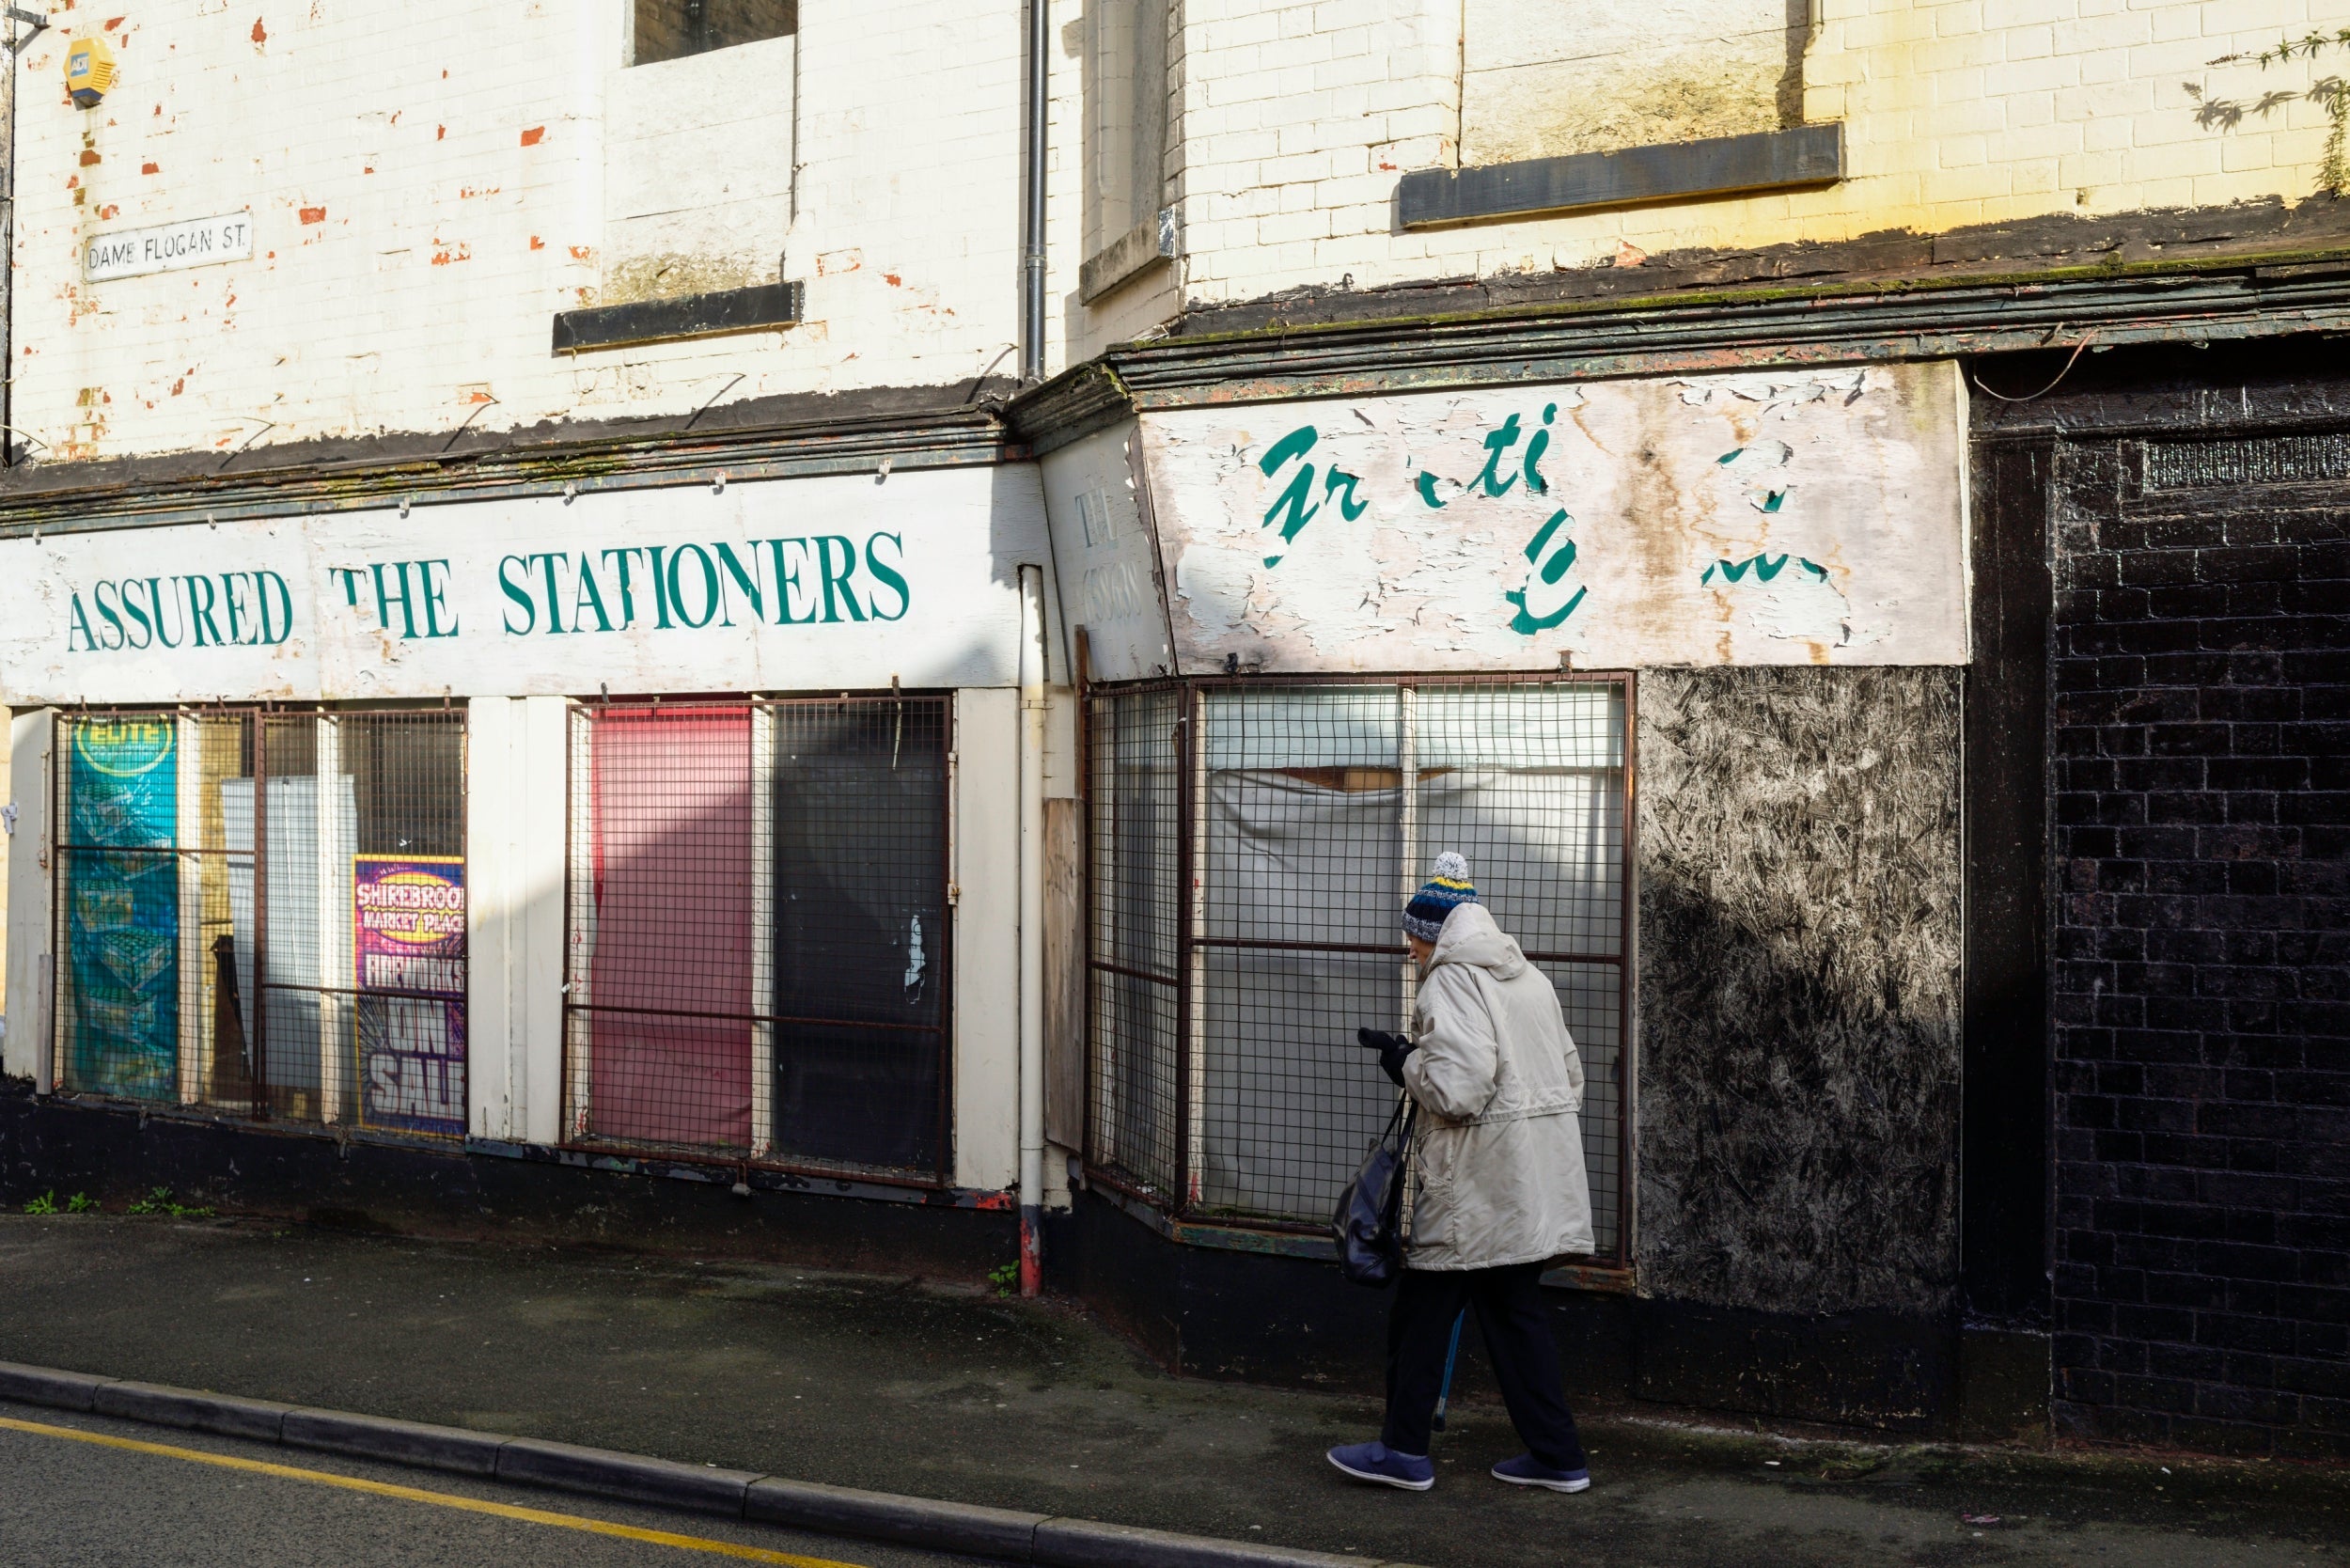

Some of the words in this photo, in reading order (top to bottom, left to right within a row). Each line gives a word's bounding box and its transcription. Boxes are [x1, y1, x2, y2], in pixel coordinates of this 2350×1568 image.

[70, 56, 89, 72] ADT
[88, 242, 135, 270] DAME
[145, 229, 212, 261] FLOGAN
[68, 569, 293, 652] ASSURED
[330, 558, 459, 639] THE
[498, 531, 910, 637] STATIONERS
[90, 723, 160, 745] ELITE
[364, 911, 419, 931] MARKET
[366, 954, 464, 992] FIREWORKS
[387, 996, 446, 1054] ON
